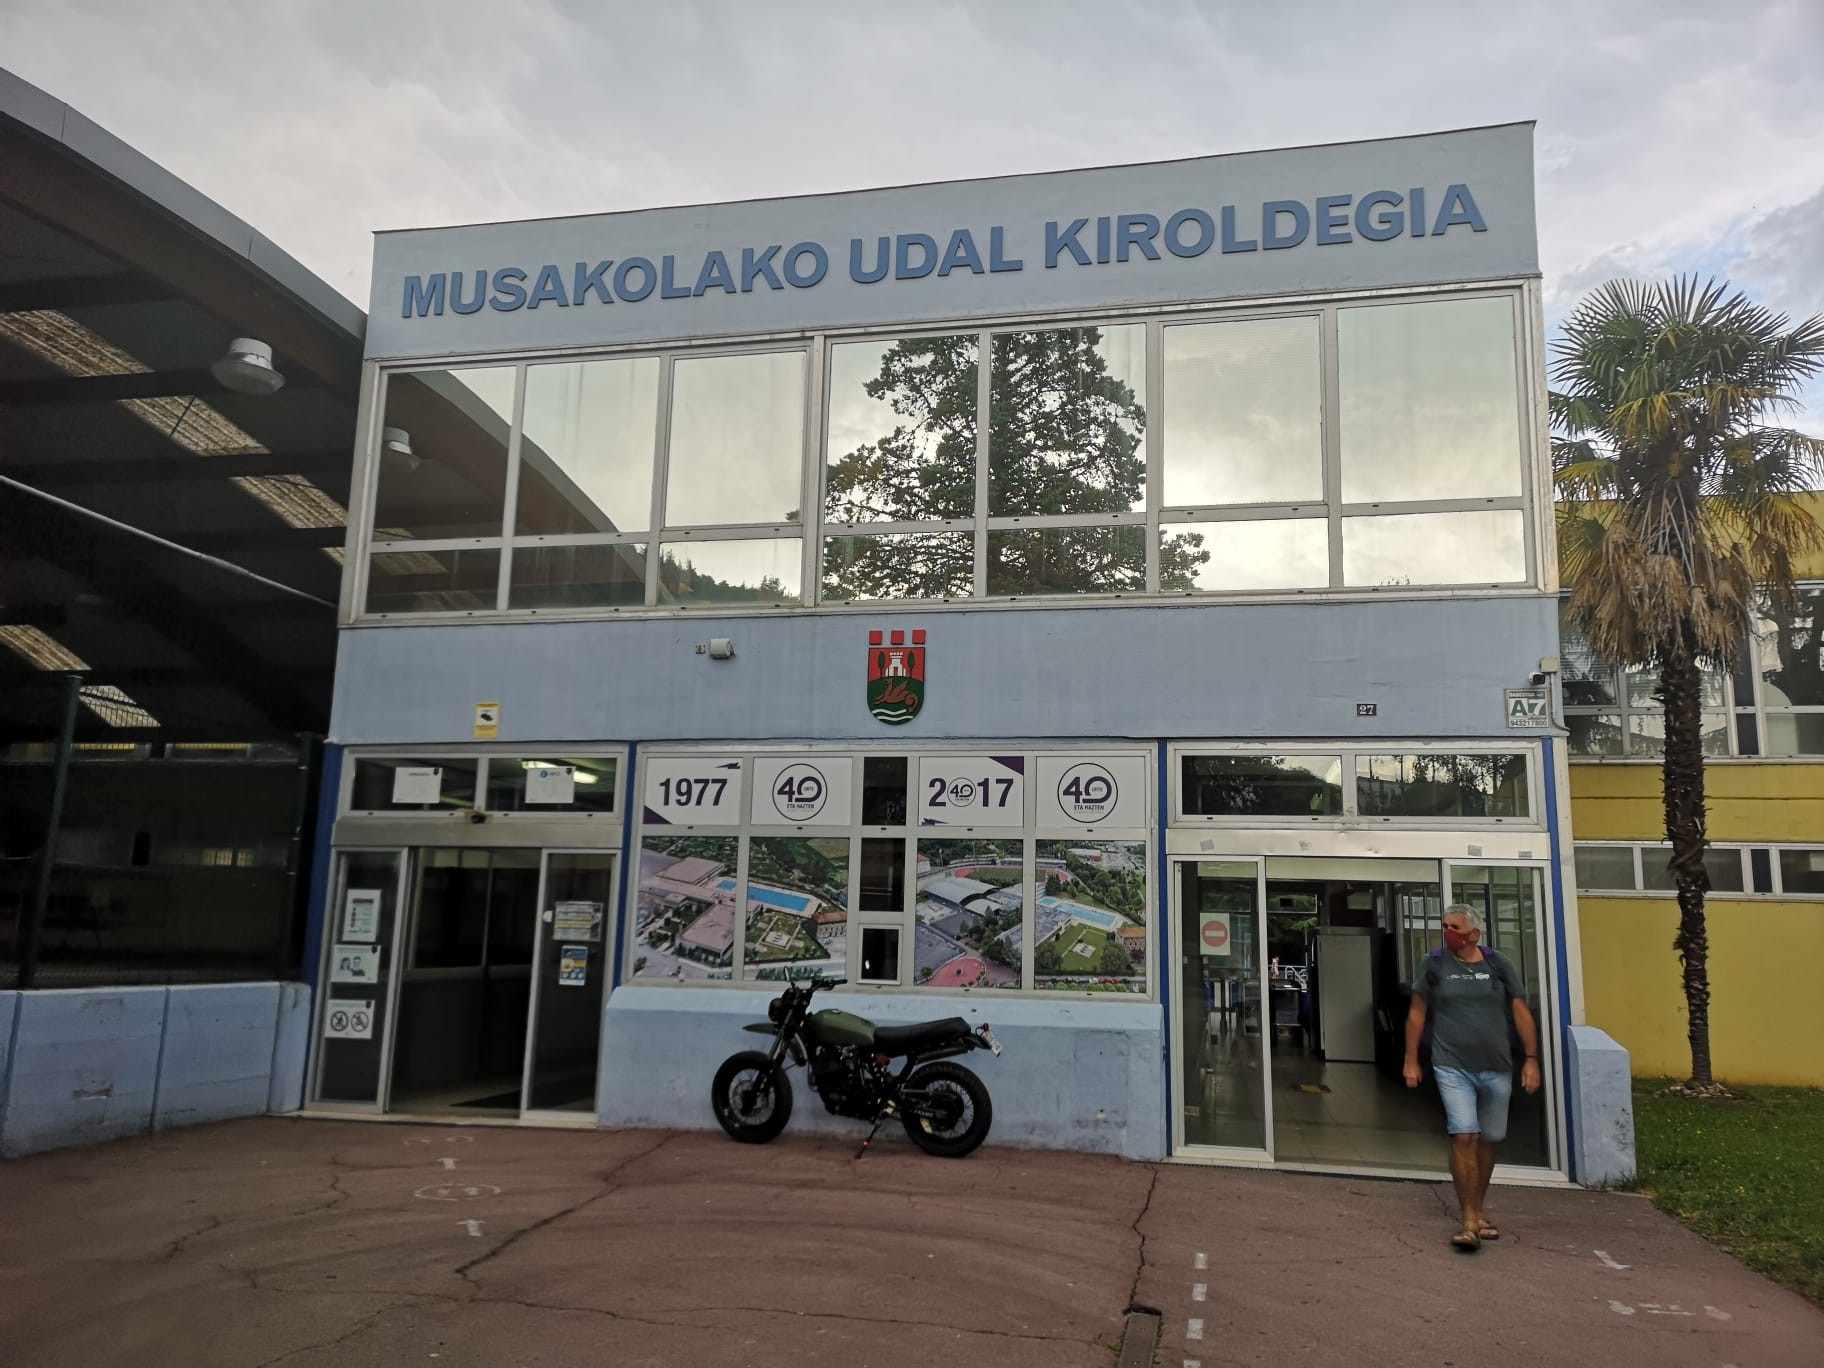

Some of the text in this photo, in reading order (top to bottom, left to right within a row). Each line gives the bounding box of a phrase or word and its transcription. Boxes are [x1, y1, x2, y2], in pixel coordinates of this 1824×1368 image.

[402, 183, 1488, 318] MUSAKOLAKO UDAL KIROLDEGIA
[1359, 704, 1374, 715] 27
[1511, 699, 1546, 716] A7
[659, 777, 728, 806] 1977
[777, 776, 822, 802] 40
[1062, 776, 1112, 804] 40
